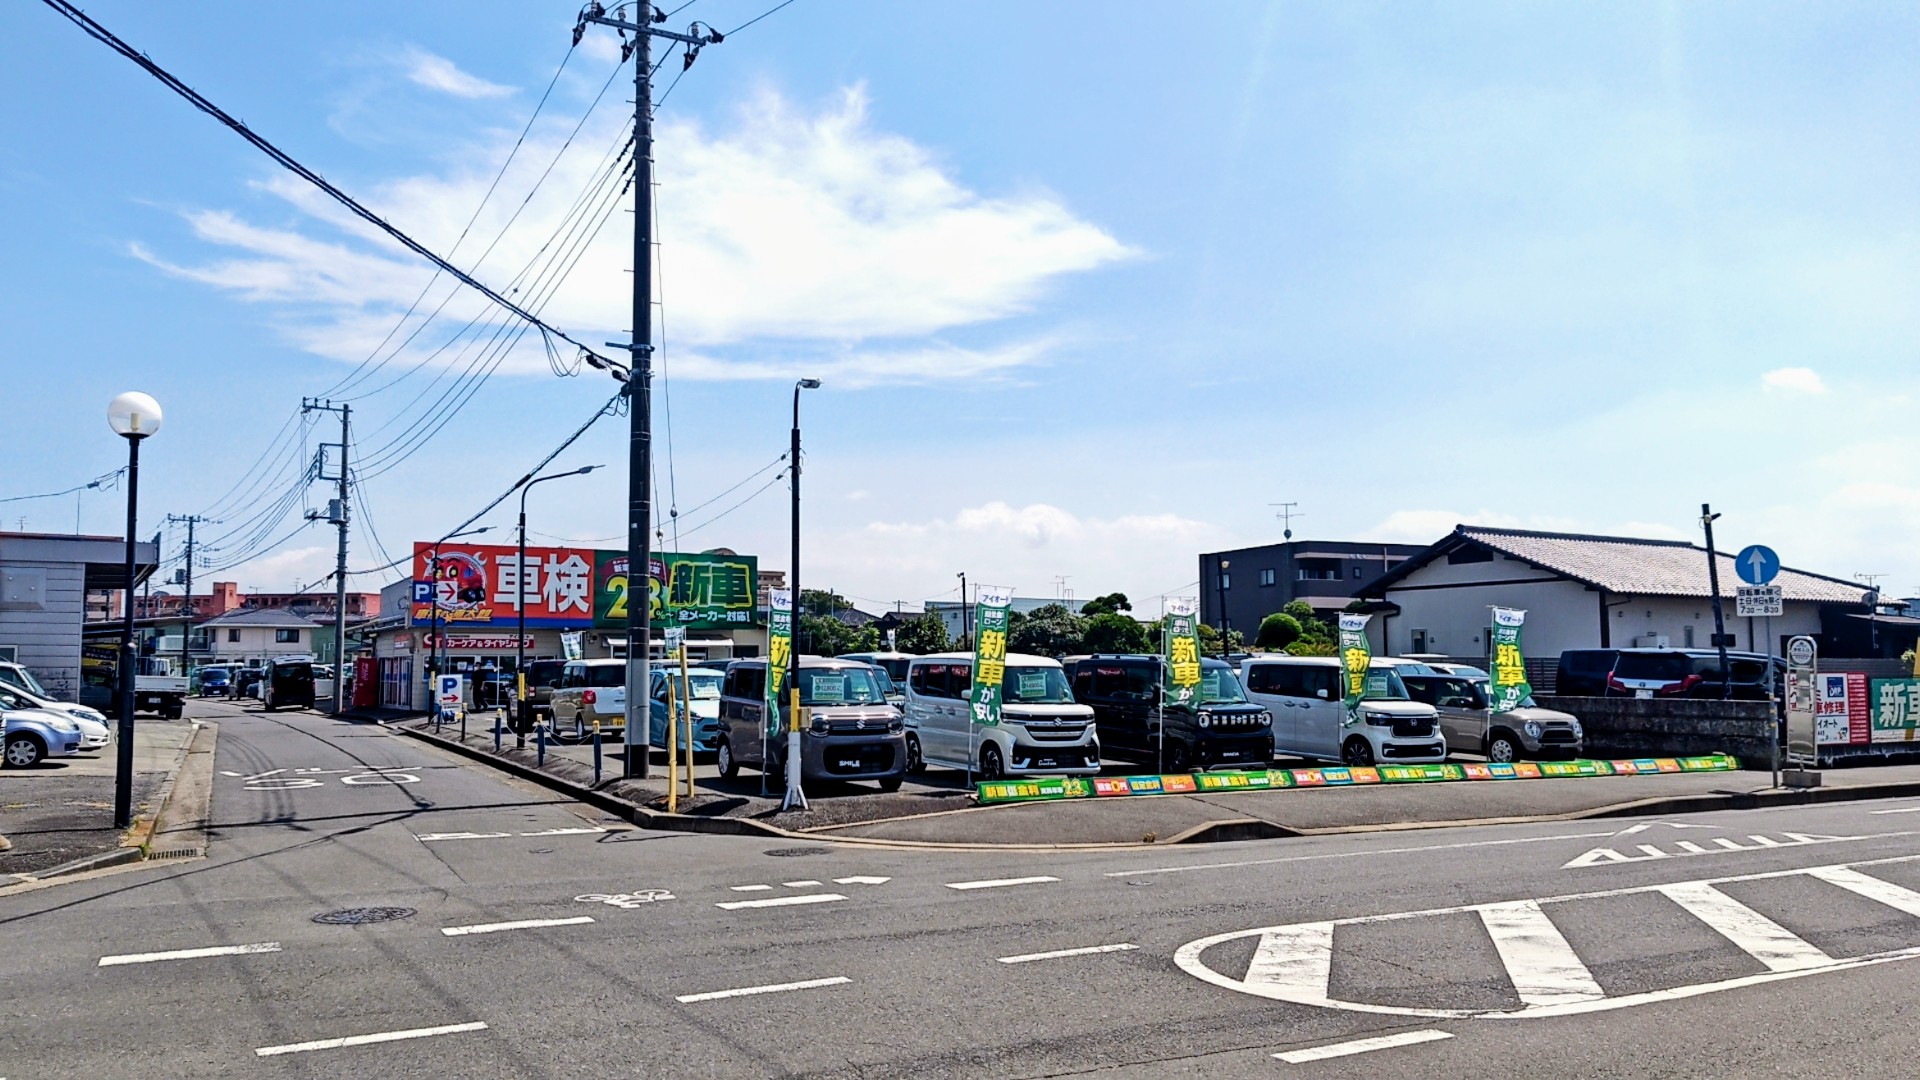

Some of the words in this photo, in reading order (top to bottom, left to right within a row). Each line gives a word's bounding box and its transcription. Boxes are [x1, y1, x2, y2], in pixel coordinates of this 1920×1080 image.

[494, 552, 591, 613] 車検
[668, 562, 752, 608] 新車
[415, 584, 430, 600] P
[678, 610, 751, 622] 全メーカー対応!
[442, 677, 458, 694] P
